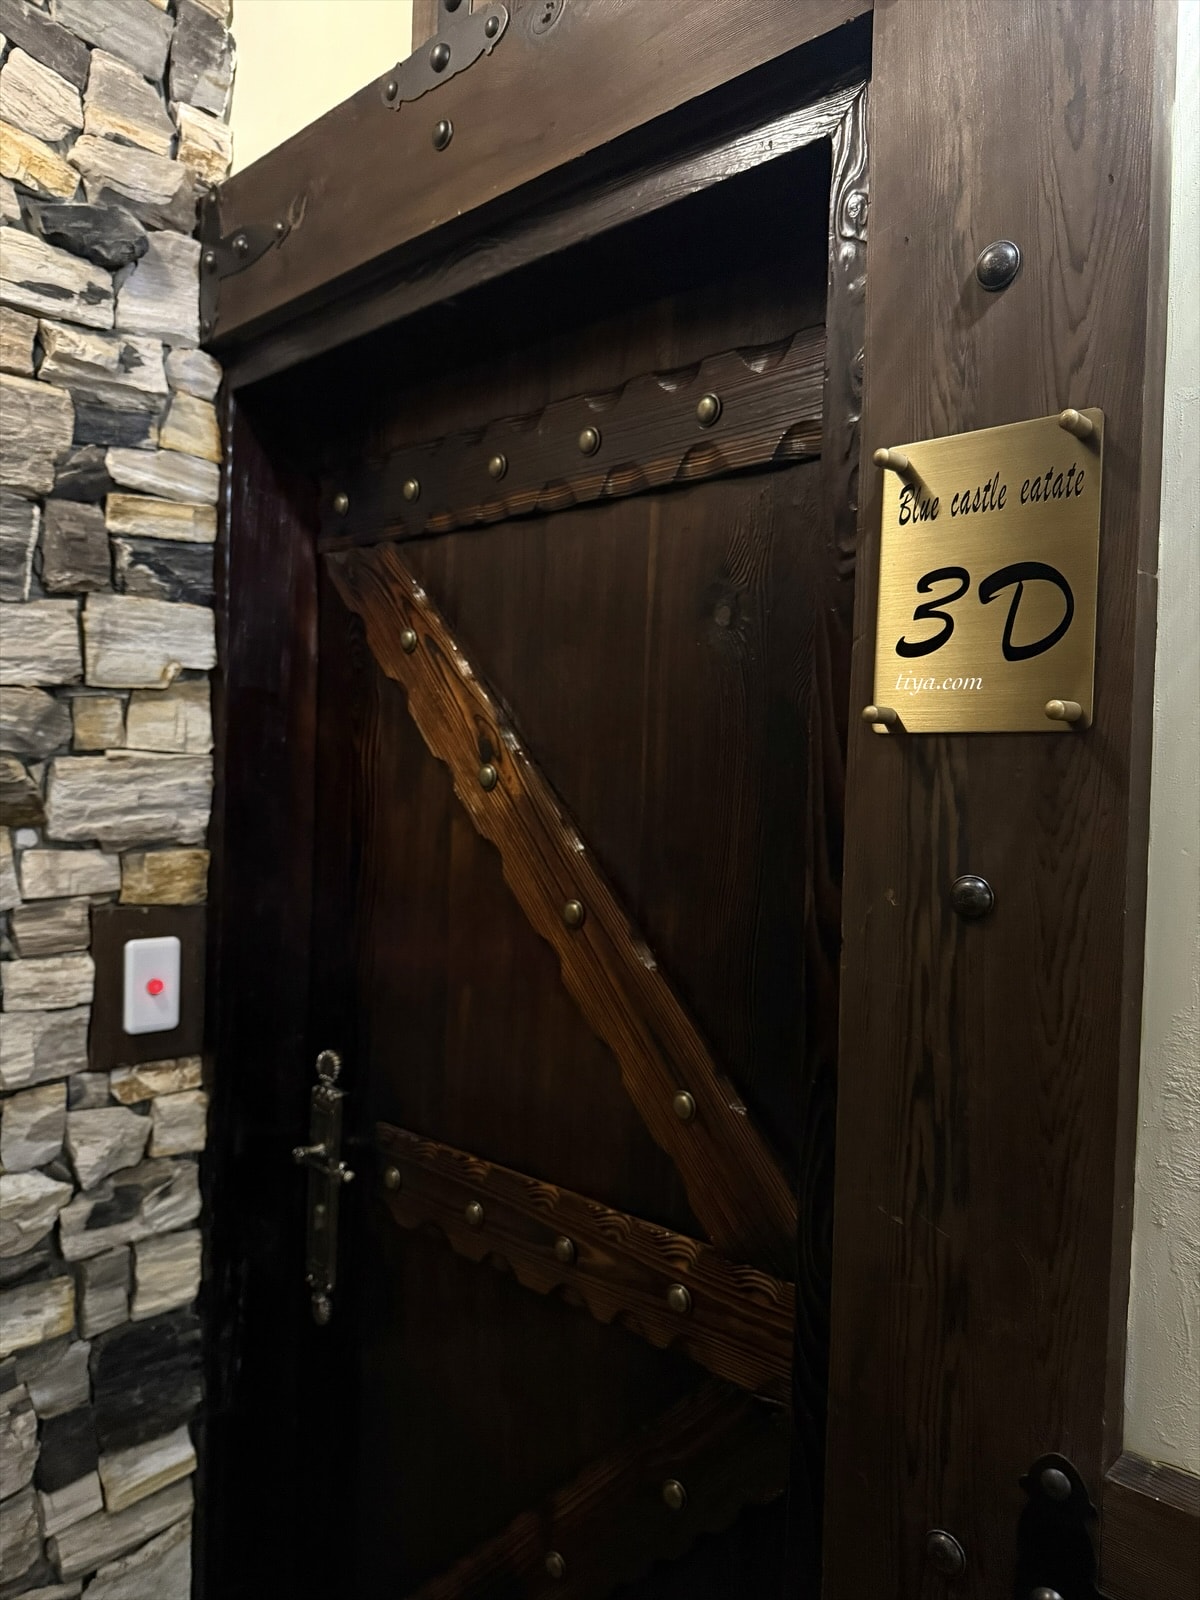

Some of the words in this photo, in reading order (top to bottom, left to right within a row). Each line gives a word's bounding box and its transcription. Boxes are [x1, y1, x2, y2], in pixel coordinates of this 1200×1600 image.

[899, 483, 939, 526] Blue
[951, 472, 1008, 518] castle
[1020, 462, 1085, 505] eatate
[895, 561, 1075, 662] 3D
